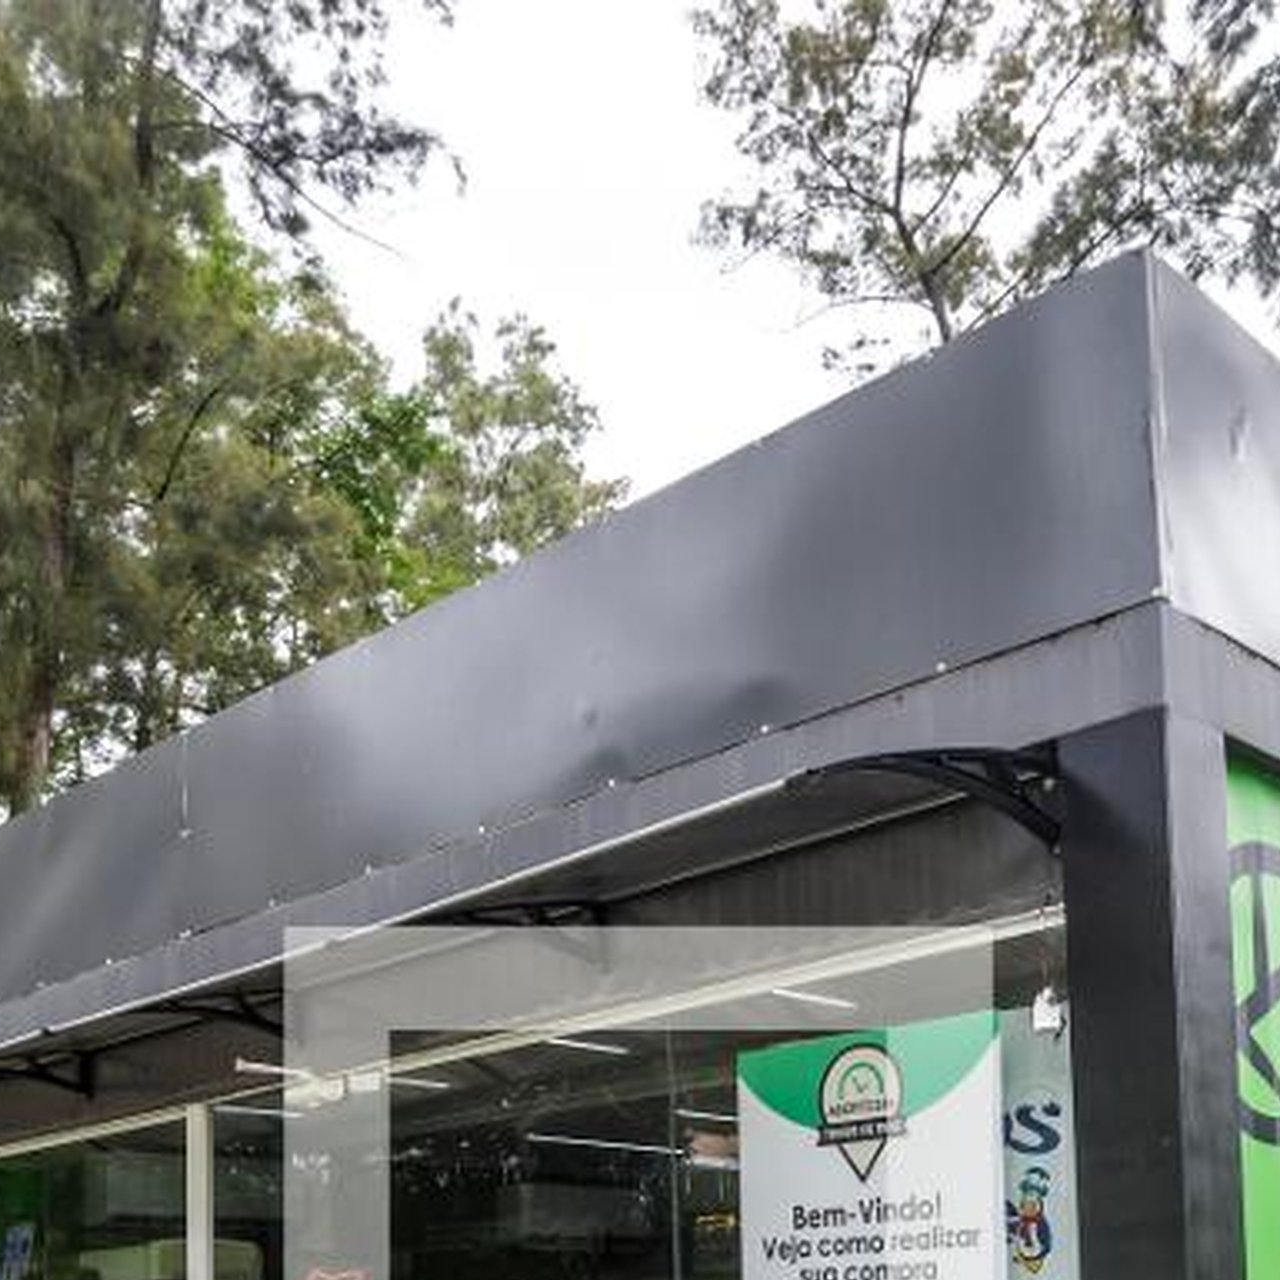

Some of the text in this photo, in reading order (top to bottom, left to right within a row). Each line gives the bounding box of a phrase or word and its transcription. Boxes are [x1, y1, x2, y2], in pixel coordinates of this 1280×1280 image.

[792, 1190, 942, 1230] Bem-Vindo!
[762, 1226, 980, 1264] Veja como realizar
